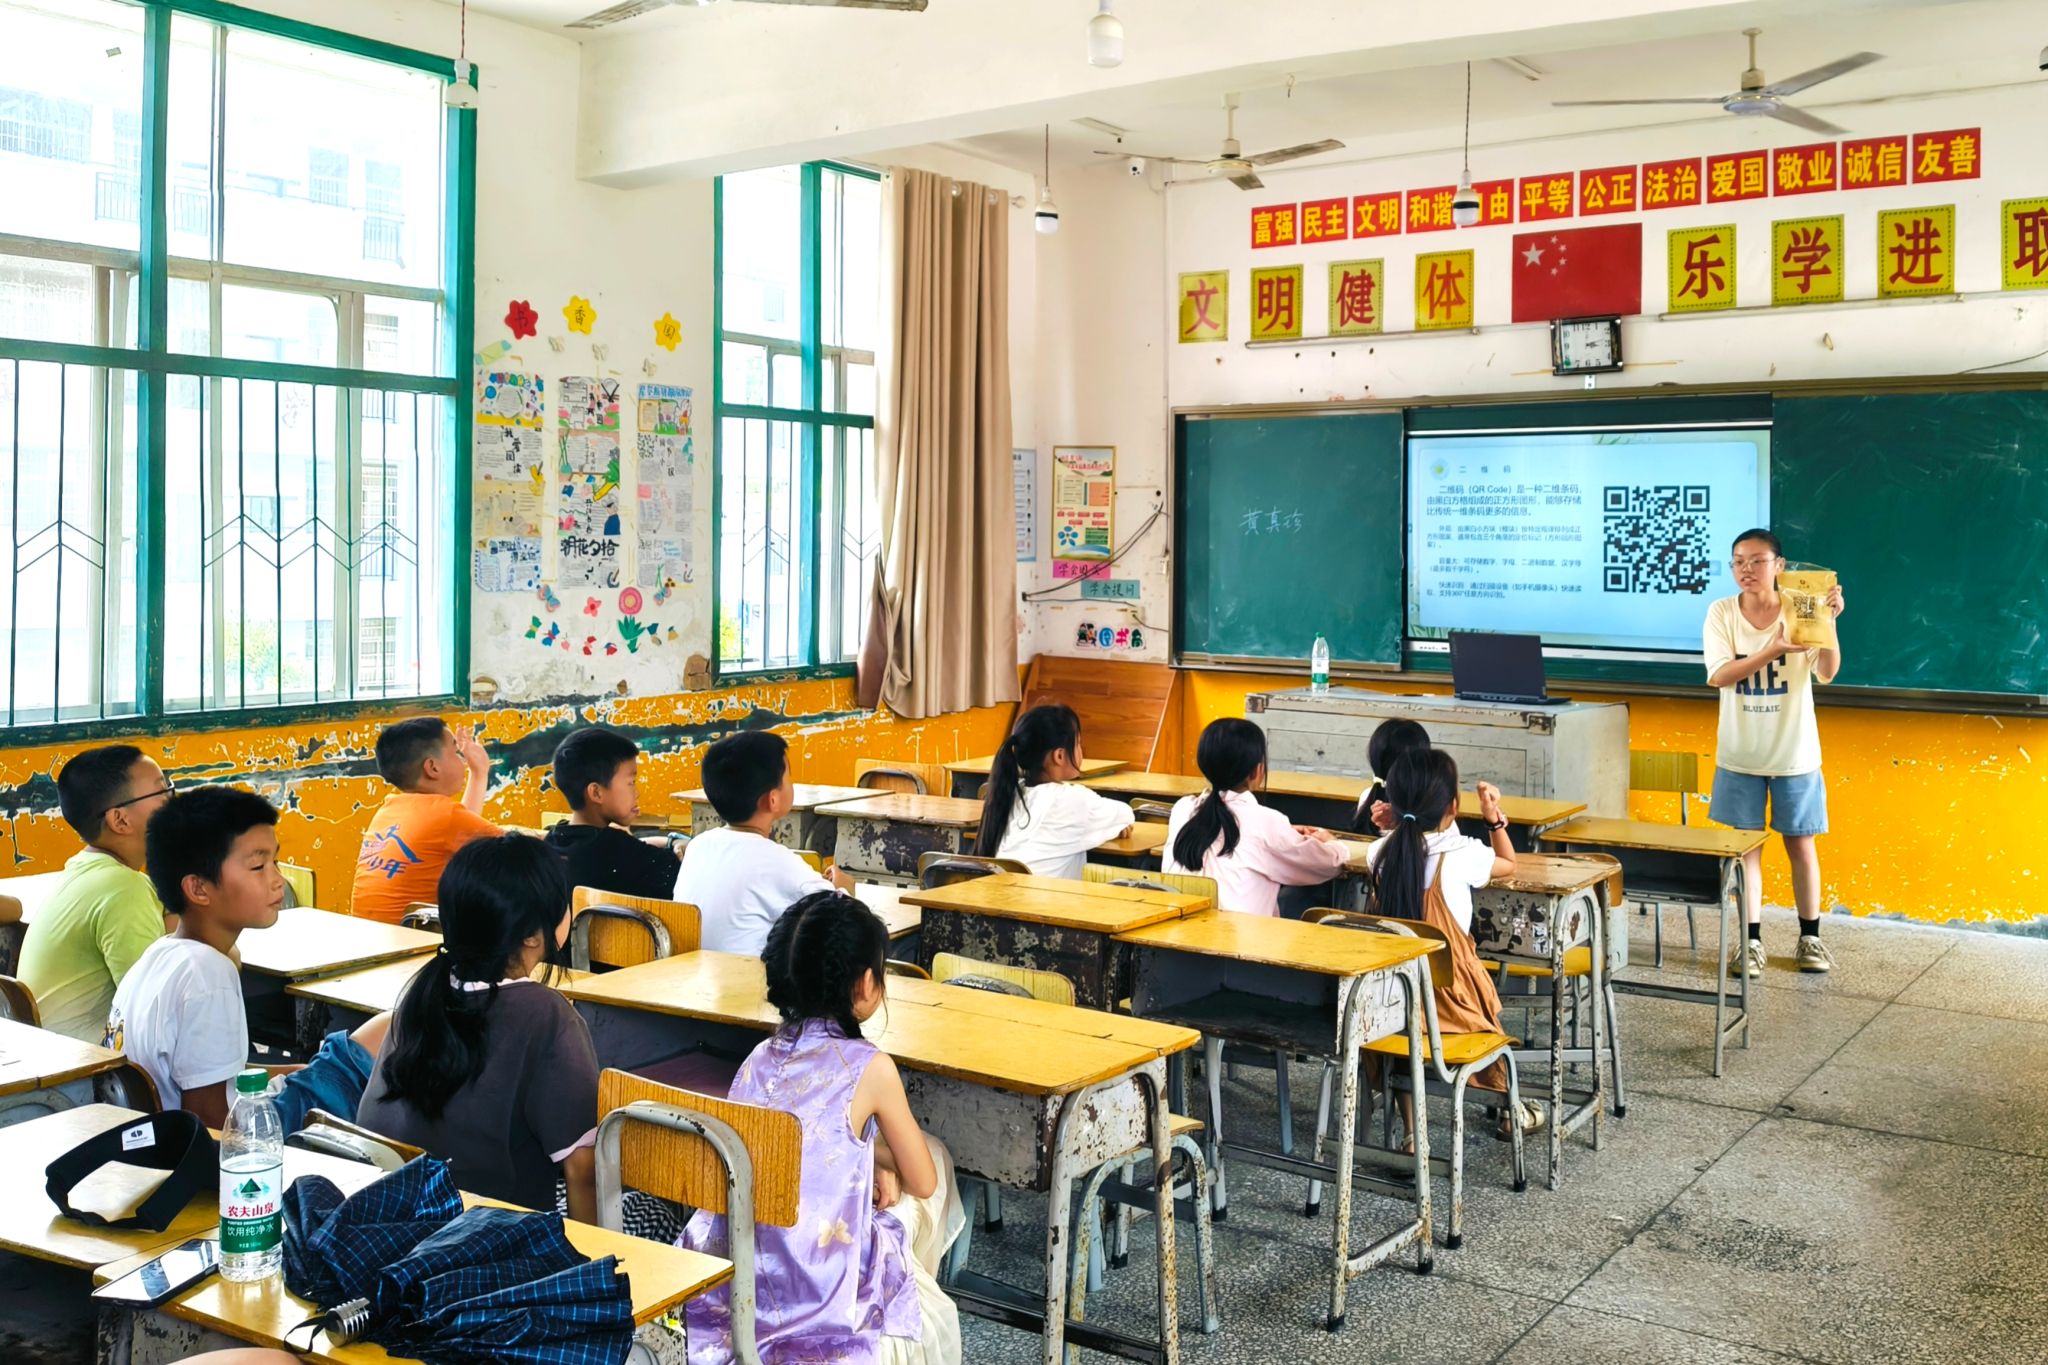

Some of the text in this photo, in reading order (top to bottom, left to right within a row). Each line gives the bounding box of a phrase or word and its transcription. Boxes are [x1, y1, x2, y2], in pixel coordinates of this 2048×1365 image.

[1254, 211, 1294, 244] 富强
[1304, 204, 1345, 238] 民主
[1356, 198, 1399, 233] 文明
[1409, 192, 1454, 228] 和谐
[1522, 178, 1572, 217] 平等
[1583, 173, 1633, 209] 公正
[1646, 165, 1698, 204] 法治
[1711, 157, 1764, 197] 爱国
[1777, 150, 1833, 190] 敬业
[1845, 142, 1903, 183] 诚信
[1917, 135, 1977, 177] 友善
[1678, 234, 1725, 299] 乐
[1783, 227, 1832, 294] 学
[1889, 218, 1943, 285] 进
[1186, 259, 1465, 335] 文 明 健 体
[366, 855, 408, 880] 少年
[227, 1222, 275, 1237] 饮用纯净水
[228, 1201, 274, 1218] 农夫山泉
